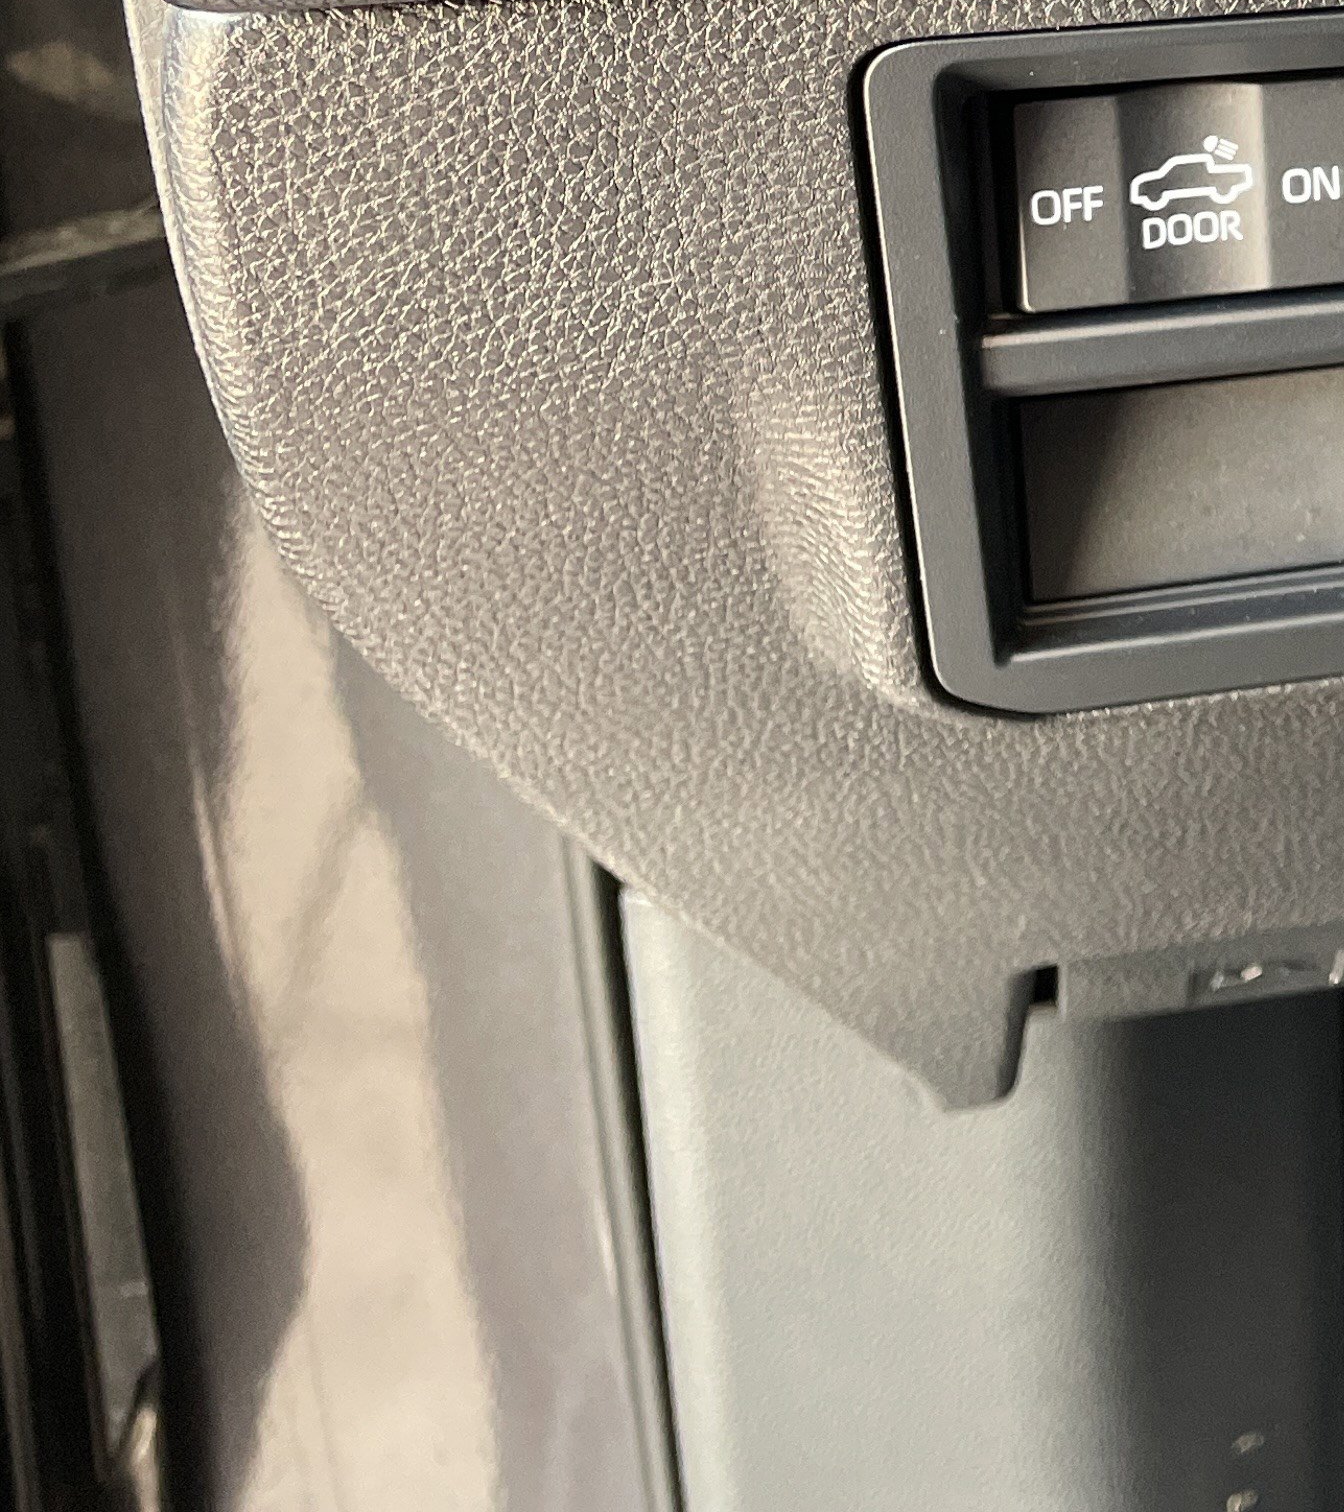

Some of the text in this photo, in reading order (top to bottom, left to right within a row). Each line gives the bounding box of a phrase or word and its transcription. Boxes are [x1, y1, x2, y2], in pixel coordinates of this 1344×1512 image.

[1030, 184, 1105, 227] OFF
[1281, 164, 1342, 205] ON
[1141, 209, 1244, 251] DOOR
